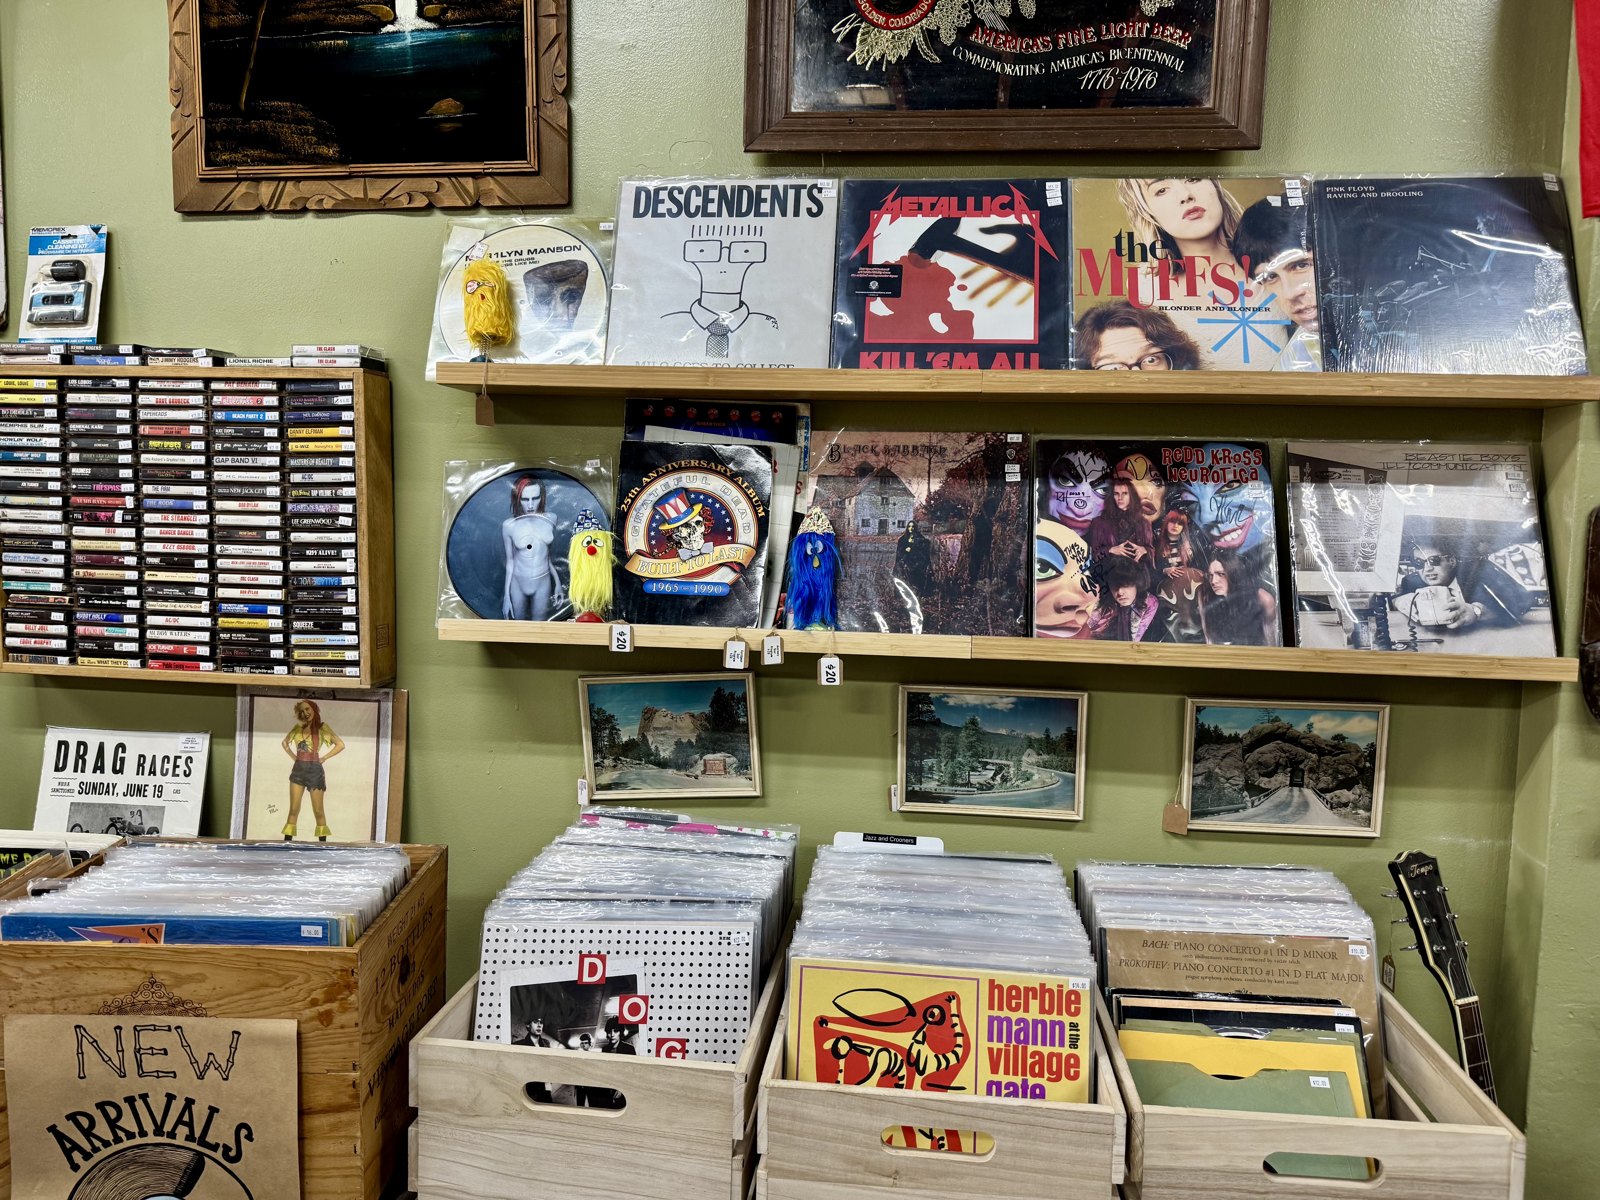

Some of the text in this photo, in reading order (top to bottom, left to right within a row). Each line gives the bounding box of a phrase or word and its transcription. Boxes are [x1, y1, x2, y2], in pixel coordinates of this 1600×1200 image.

[969, 22, 1192, 53] AMERICA'S FINE LIGHT BEER
[952, 46, 1186, 76] COMMEMORATING AMERICA'S BICENTENNIAL
[1077, 66, 1159, 91] 1776-1976
[632, 184, 824, 219] DESCENDENTS
[1113, 228, 1169, 263] the
[1075, 248, 1254, 310] MUFFS!
[1404, 453, 1523, 463] BEASTIE BOYS
[1410, 462, 1528, 472] COMMUNICATION
[620, 459, 766, 517] 25th ANNIVERSARY ALBUM
[631, 474, 752, 537] GRATEFUL DEAD
[637, 546, 748, 576] BUILT TO LAST
[651, 582, 723, 594] 1965 1990
[616, 630, 627, 651] $20
[825, 664, 836, 684] $20
[53, 739, 194, 778] DRAG RACES
[77, 781, 164, 799] SUNDAY, JUNE 19
[889, 836, 915, 844] Crooners
[1142, 940, 1170, 950] BACH:
[1174, 941, 1205, 952] PIANO
[1207, 943, 1261, 955] CONCERTO
[1276, 948, 1289, 957] IN
[1292, 949, 1300, 958] D
[1303, 950, 1338, 960] MINOR
[374, 967, 387, 998] 12
[582, 957, 604, 983] D
[1119, 958, 1170, 970] PROKOFIEV:
[1173, 961, 1204, 972] PIANO
[1207, 964, 1263, 976] CONCERTO
[1278, 969, 1290, 978] IN
[1293, 970, 1302, 979] D
[1305, 970, 1328, 980] FLAT
[1331, 972, 1365, 984] MAJOR
[622, 996, 647, 1022] O
[987, 978, 1082, 1018] herbie
[987, 1014, 1066, 1048] mann
[1068, 1021, 1080, 1050] at the
[73, 1024, 242, 1081] NEW
[660, 1040, 683, 1060] G
[987, 1043, 1081, 1083] village
[46, 1092, 255, 1173] ARRIVALS
